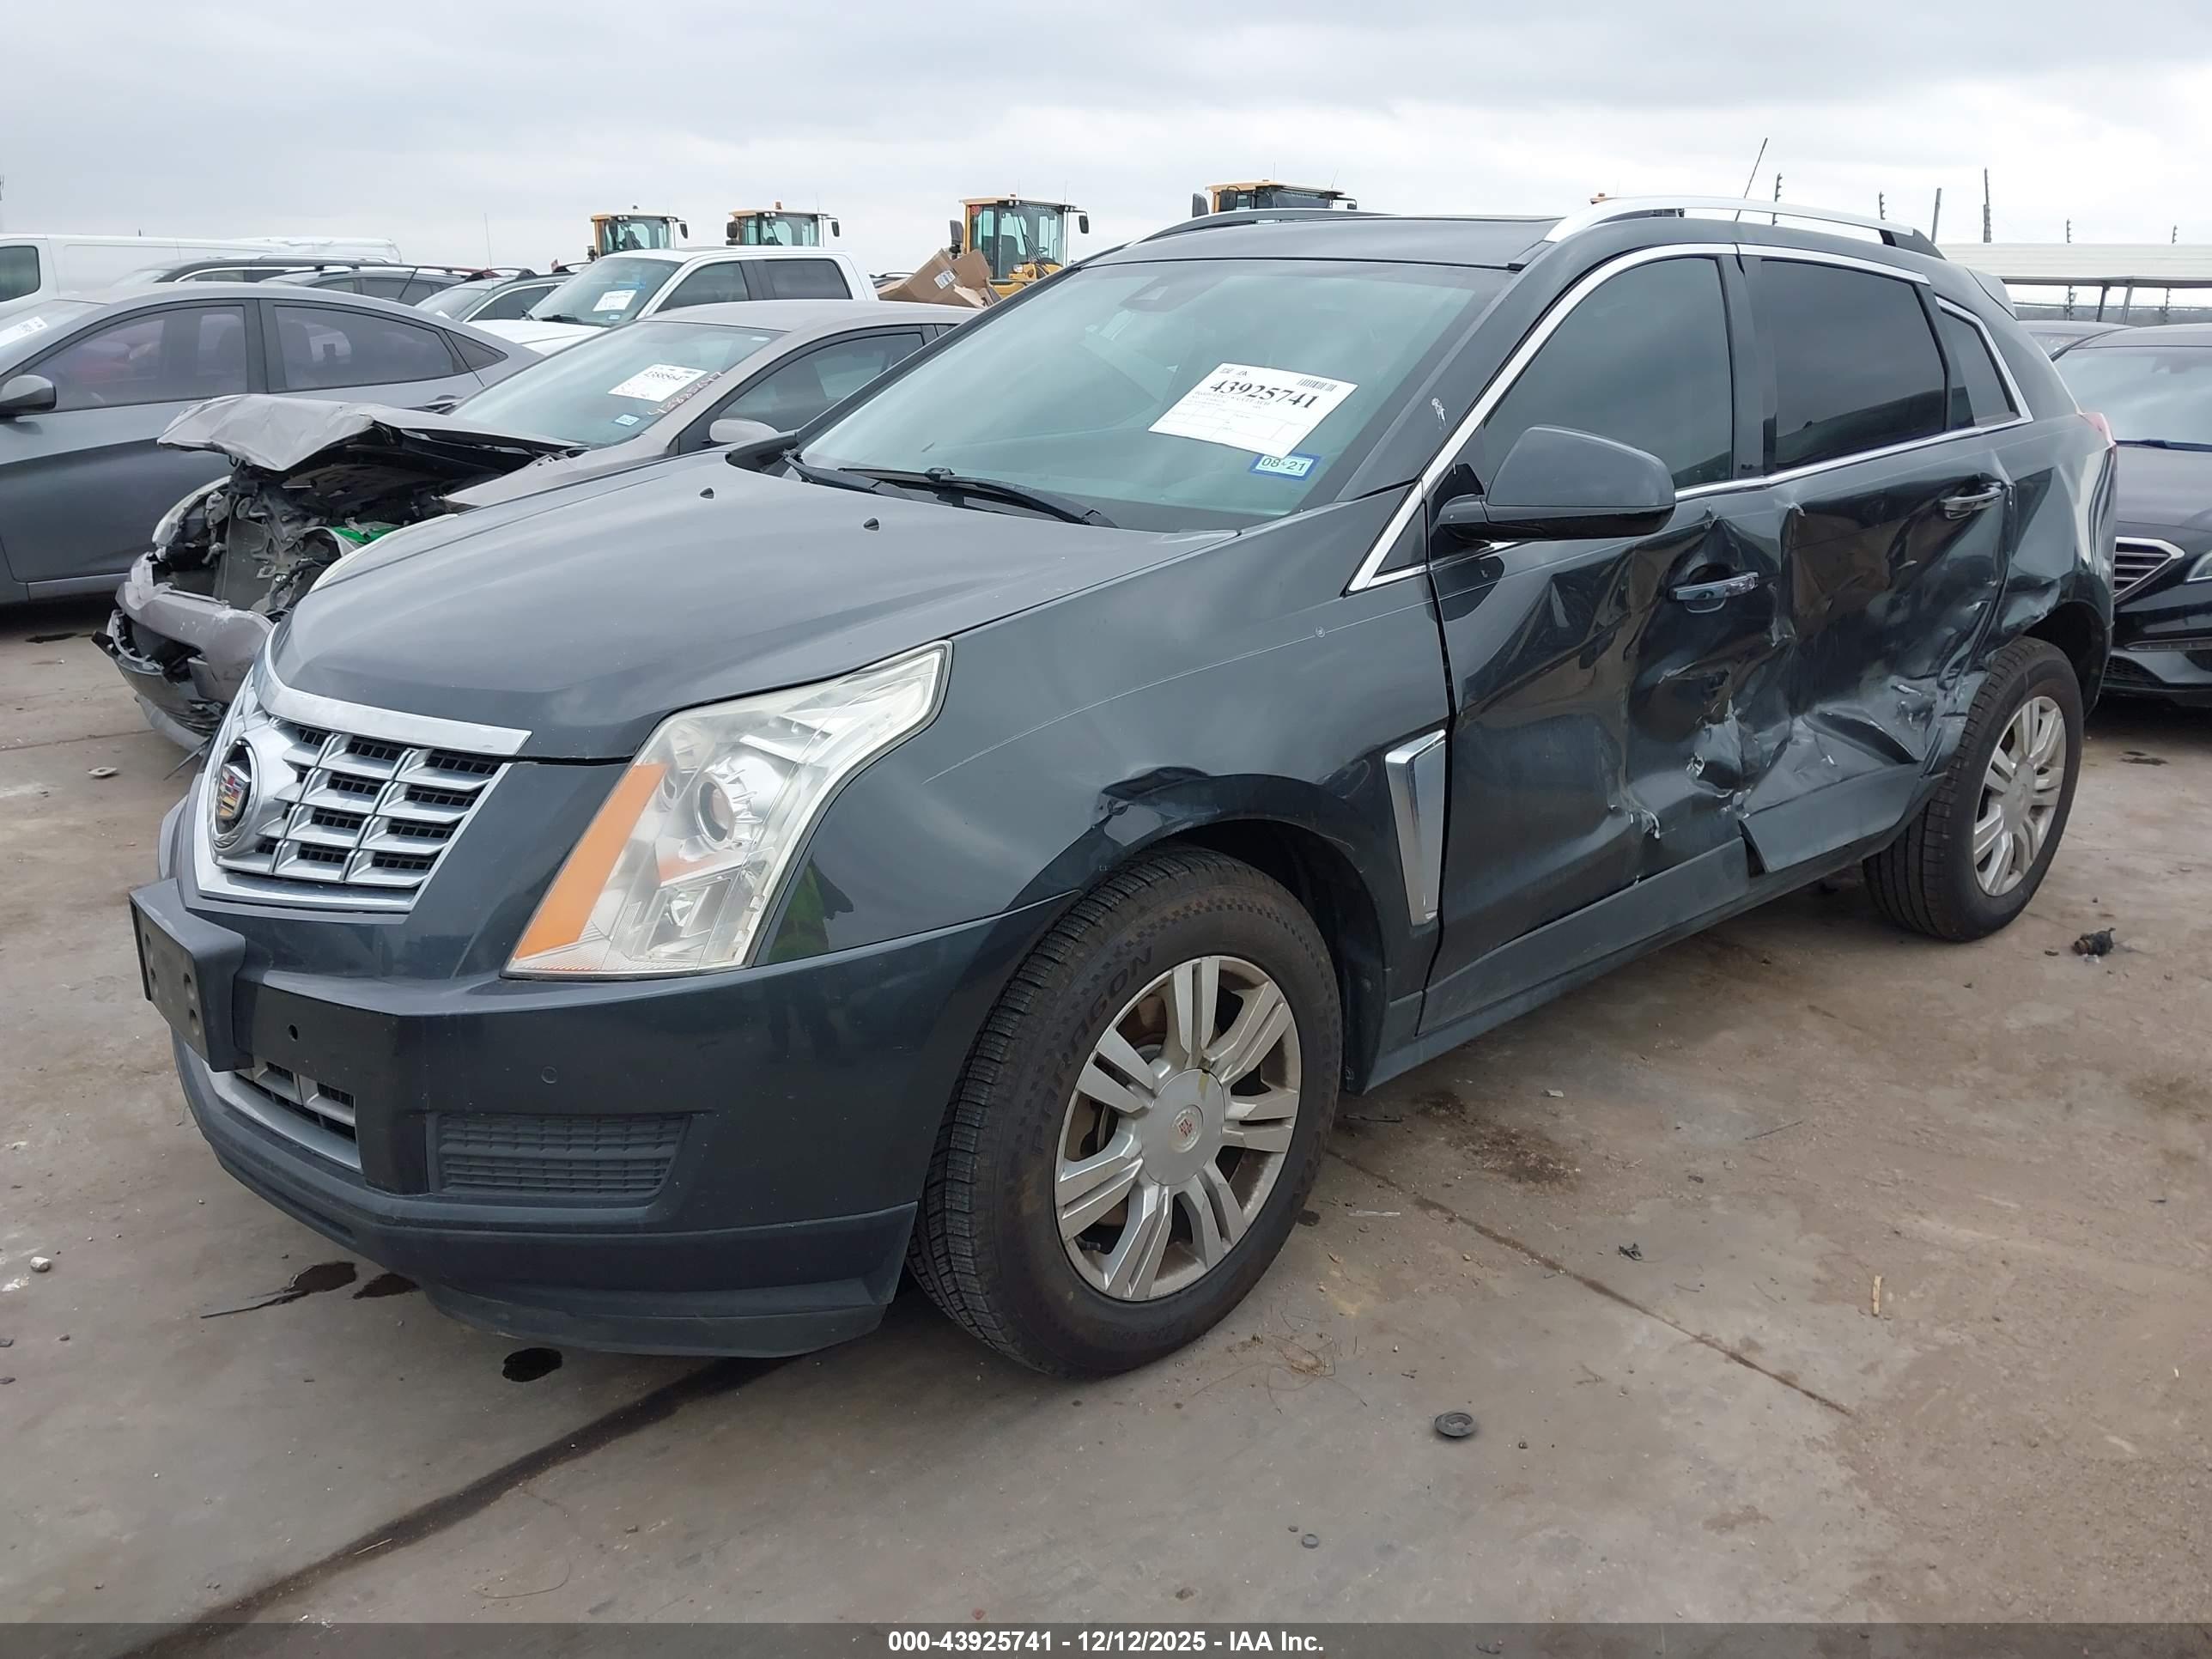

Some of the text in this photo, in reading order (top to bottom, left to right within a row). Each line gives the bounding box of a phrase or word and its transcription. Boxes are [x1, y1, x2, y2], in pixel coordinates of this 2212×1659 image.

[1209, 379, 1320, 410] 43925741
[1261, 457, 1306, 472] 08 21
